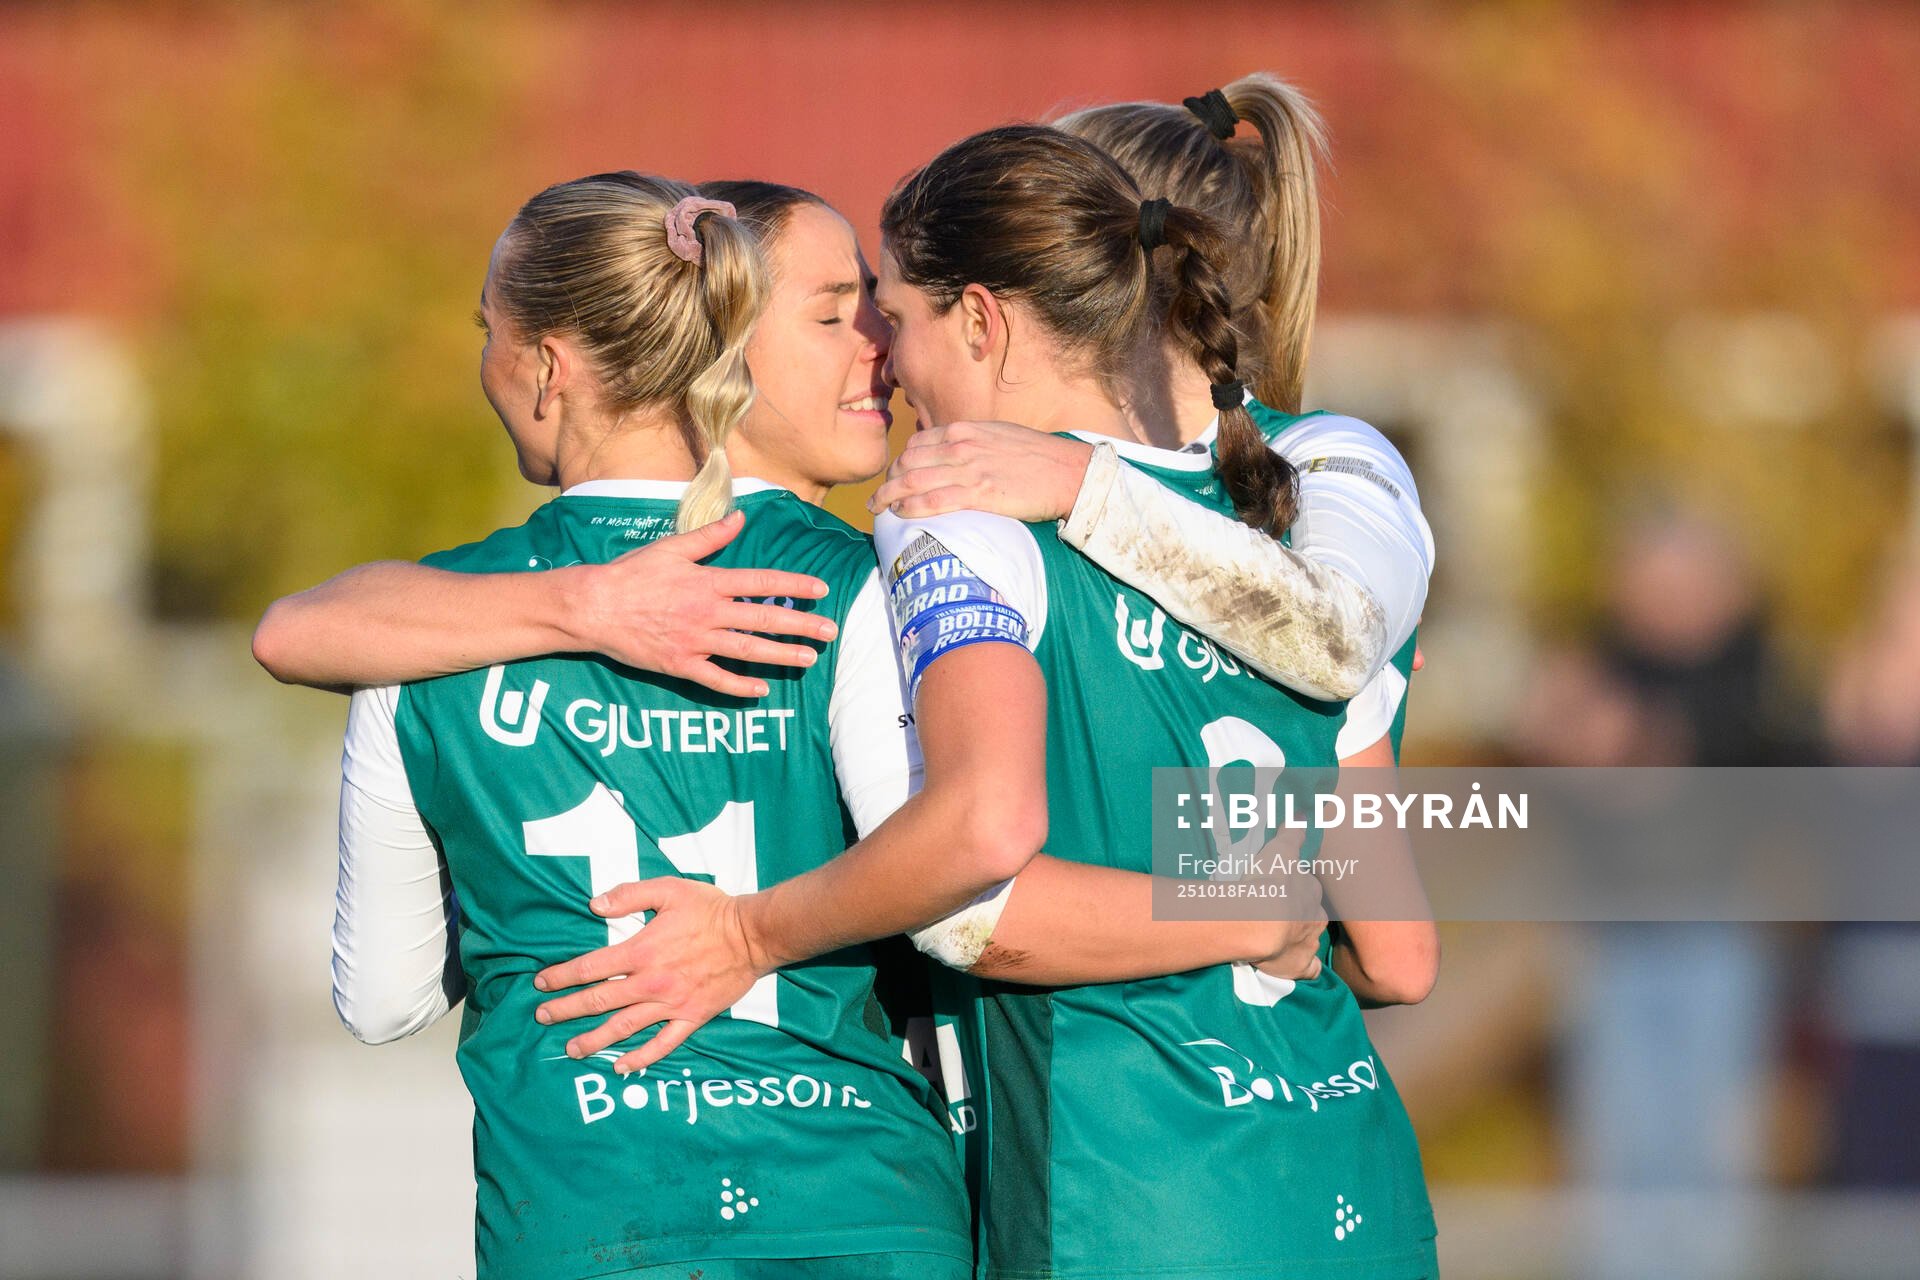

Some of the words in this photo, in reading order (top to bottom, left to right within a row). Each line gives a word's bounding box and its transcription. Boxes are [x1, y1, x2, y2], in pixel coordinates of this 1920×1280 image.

[591, 516, 606, 525] EN
[624, 529, 648, 541] HELA
[939, 611, 1023, 638] BOLLEN
[1178, 630, 1254, 683] GJU
[565, 698, 795, 758] GJUTERIET
[522, 781, 779, 1028] 11
